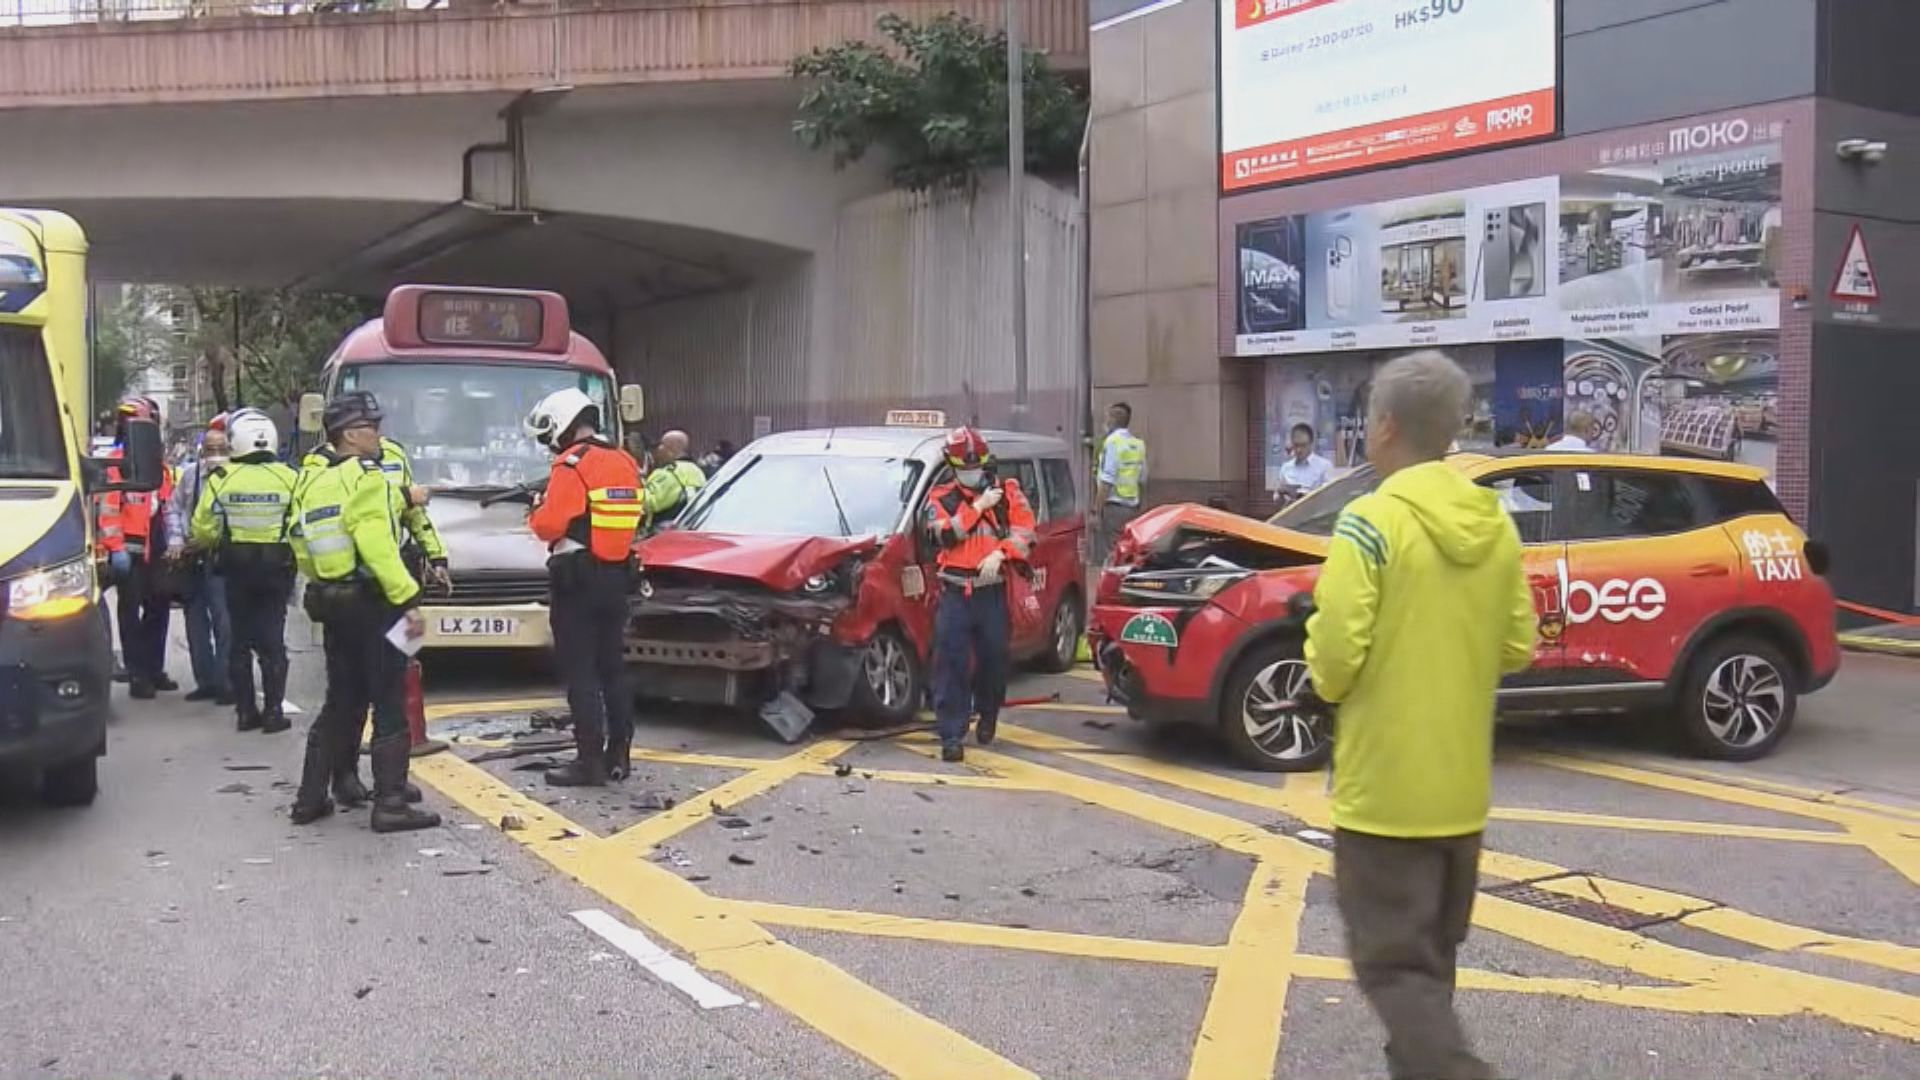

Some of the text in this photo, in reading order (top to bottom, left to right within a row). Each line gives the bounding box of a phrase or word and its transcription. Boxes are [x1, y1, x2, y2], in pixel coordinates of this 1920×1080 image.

[1487, 104, 1533, 128] MOKO
[1669, 118, 1749, 153] MOKO
[1244, 265, 1297, 288] IMAX
[1742, 529, 1797, 557] 的士
[1750, 557, 1802, 581] TAXI
[441, 617, 512, 634] LX 2181
[1144, 621, 1155, 634] 4
